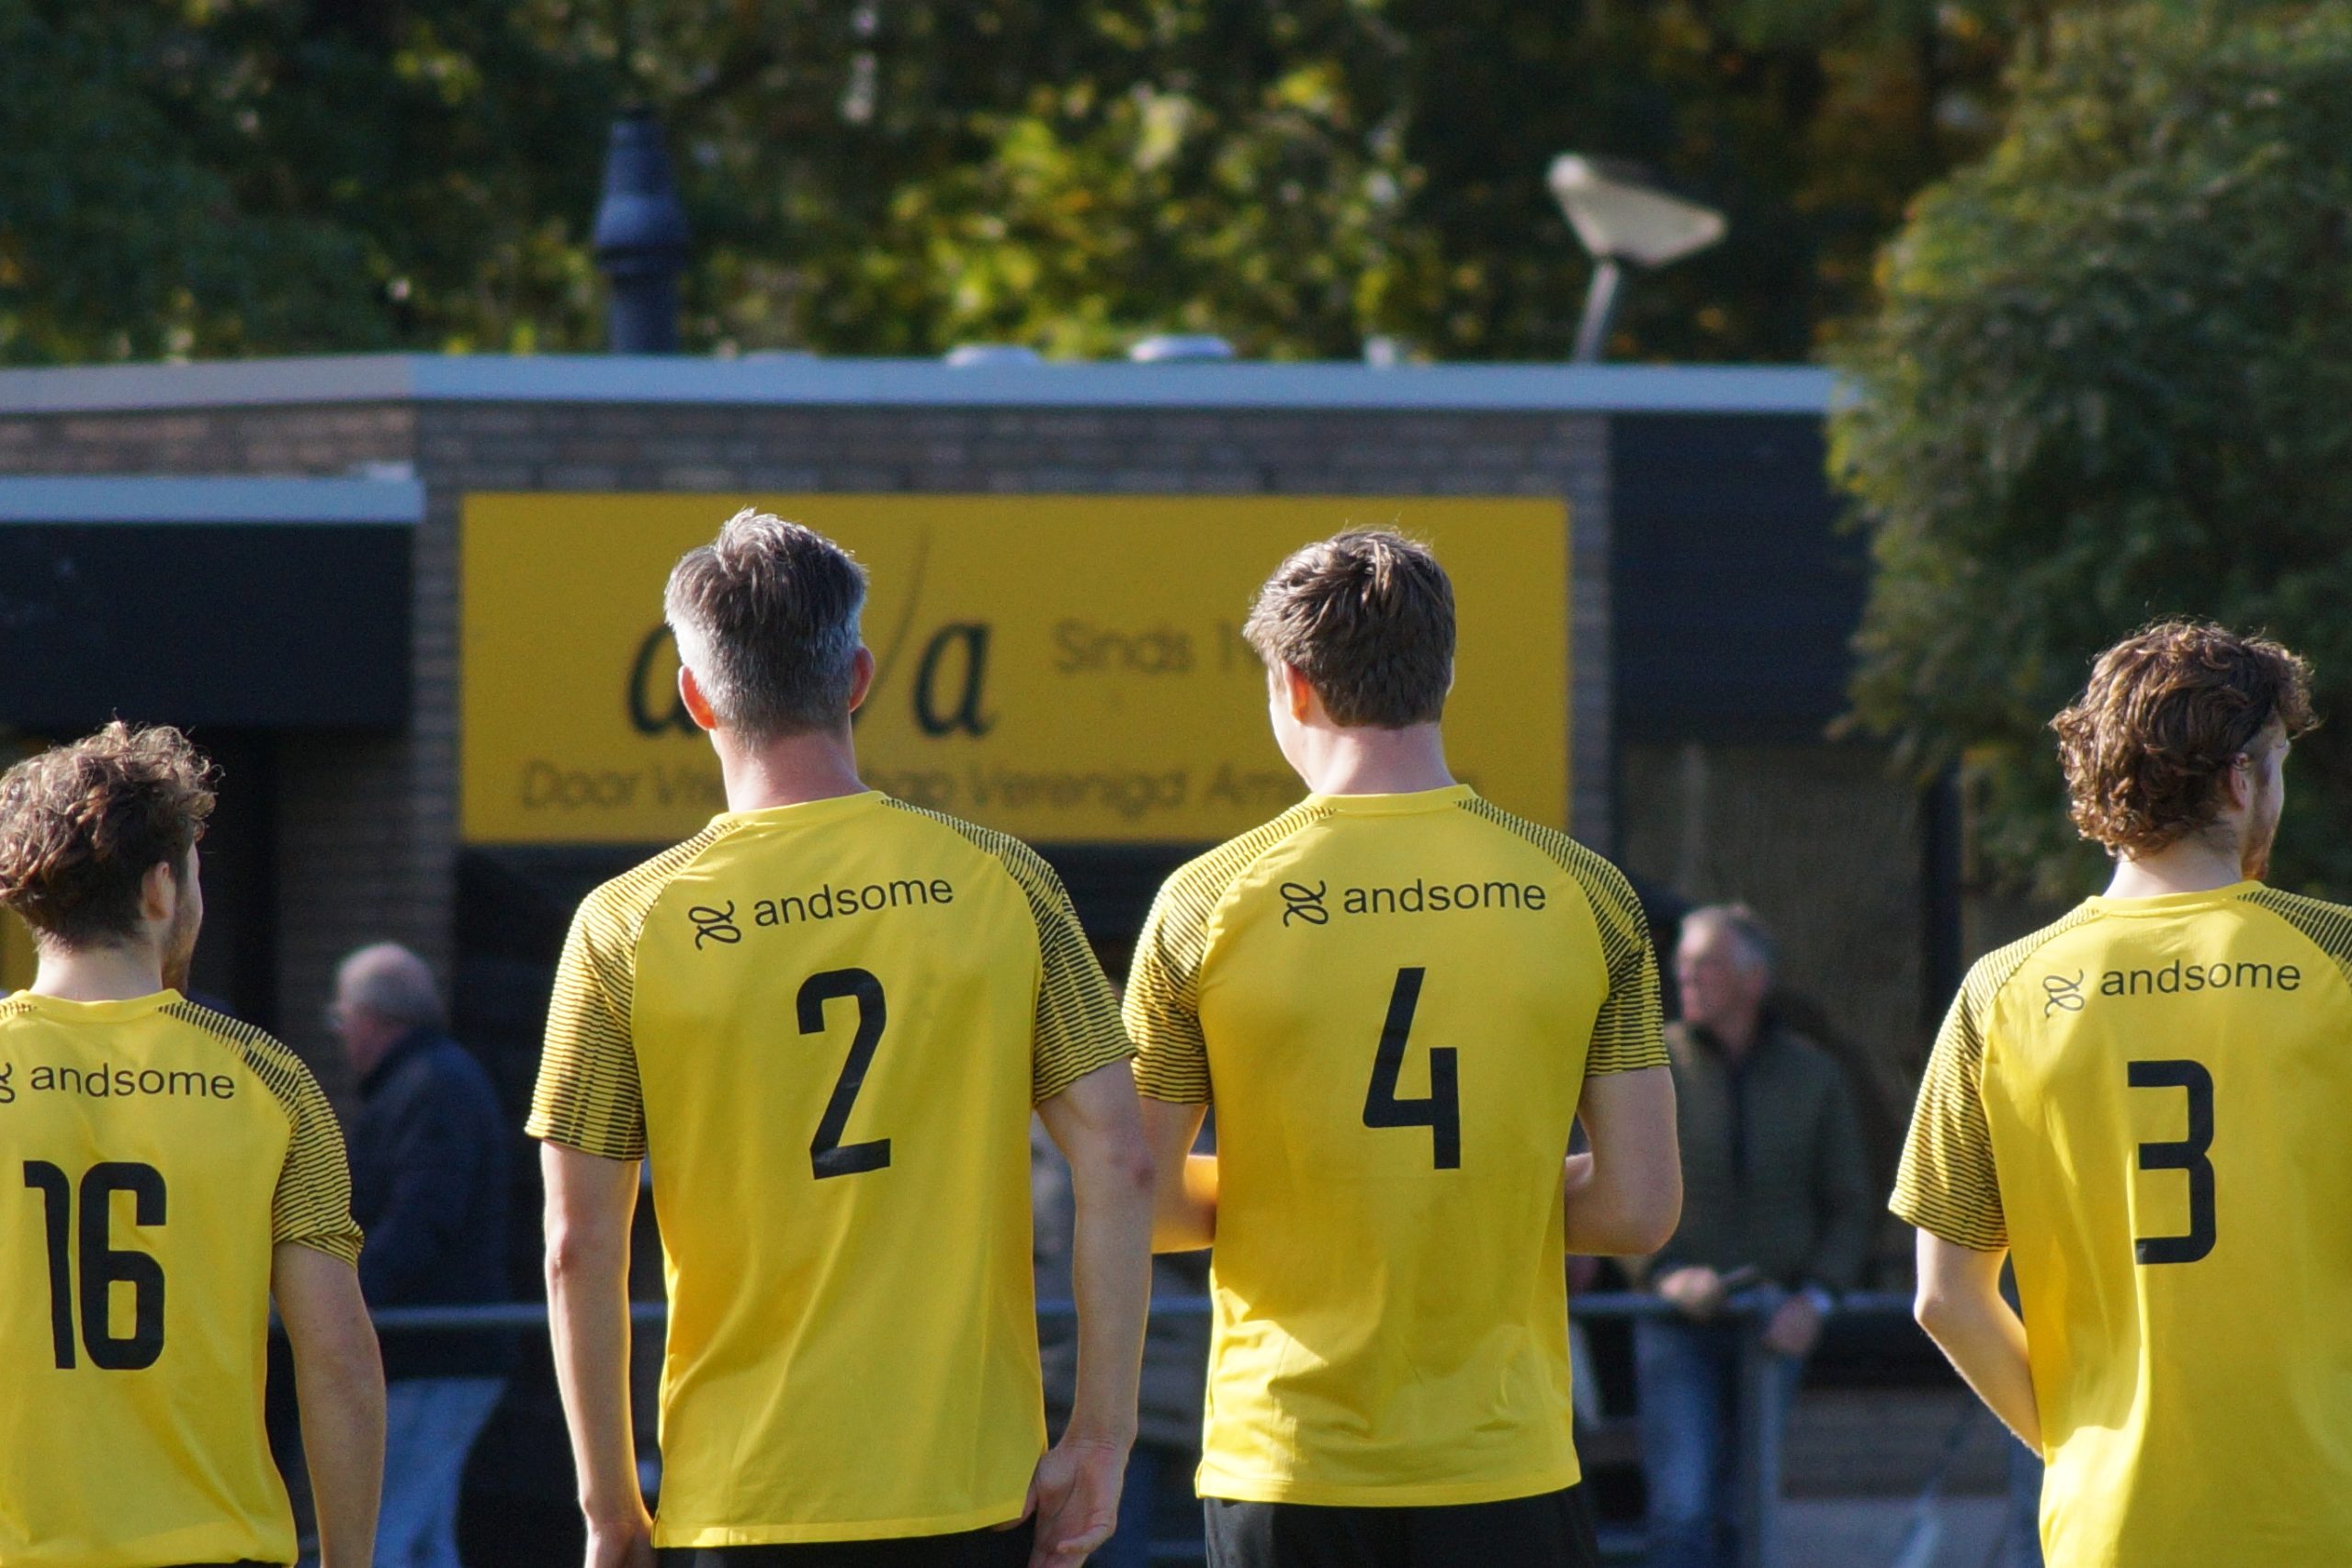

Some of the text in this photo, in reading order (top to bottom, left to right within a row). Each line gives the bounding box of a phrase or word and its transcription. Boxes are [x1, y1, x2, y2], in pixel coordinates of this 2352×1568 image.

[753, 878, 954, 927] andsome
[1343, 878, 1546, 914] andsome
[2100, 959, 2301, 996] andsome
[30, 1063, 235, 1100] andsome
[796, 967, 891, 1180] 2
[1363, 966, 1461, 1170] 4
[2127, 1059, 2217, 1265] 3
[22, 1159, 167, 1371] 16
